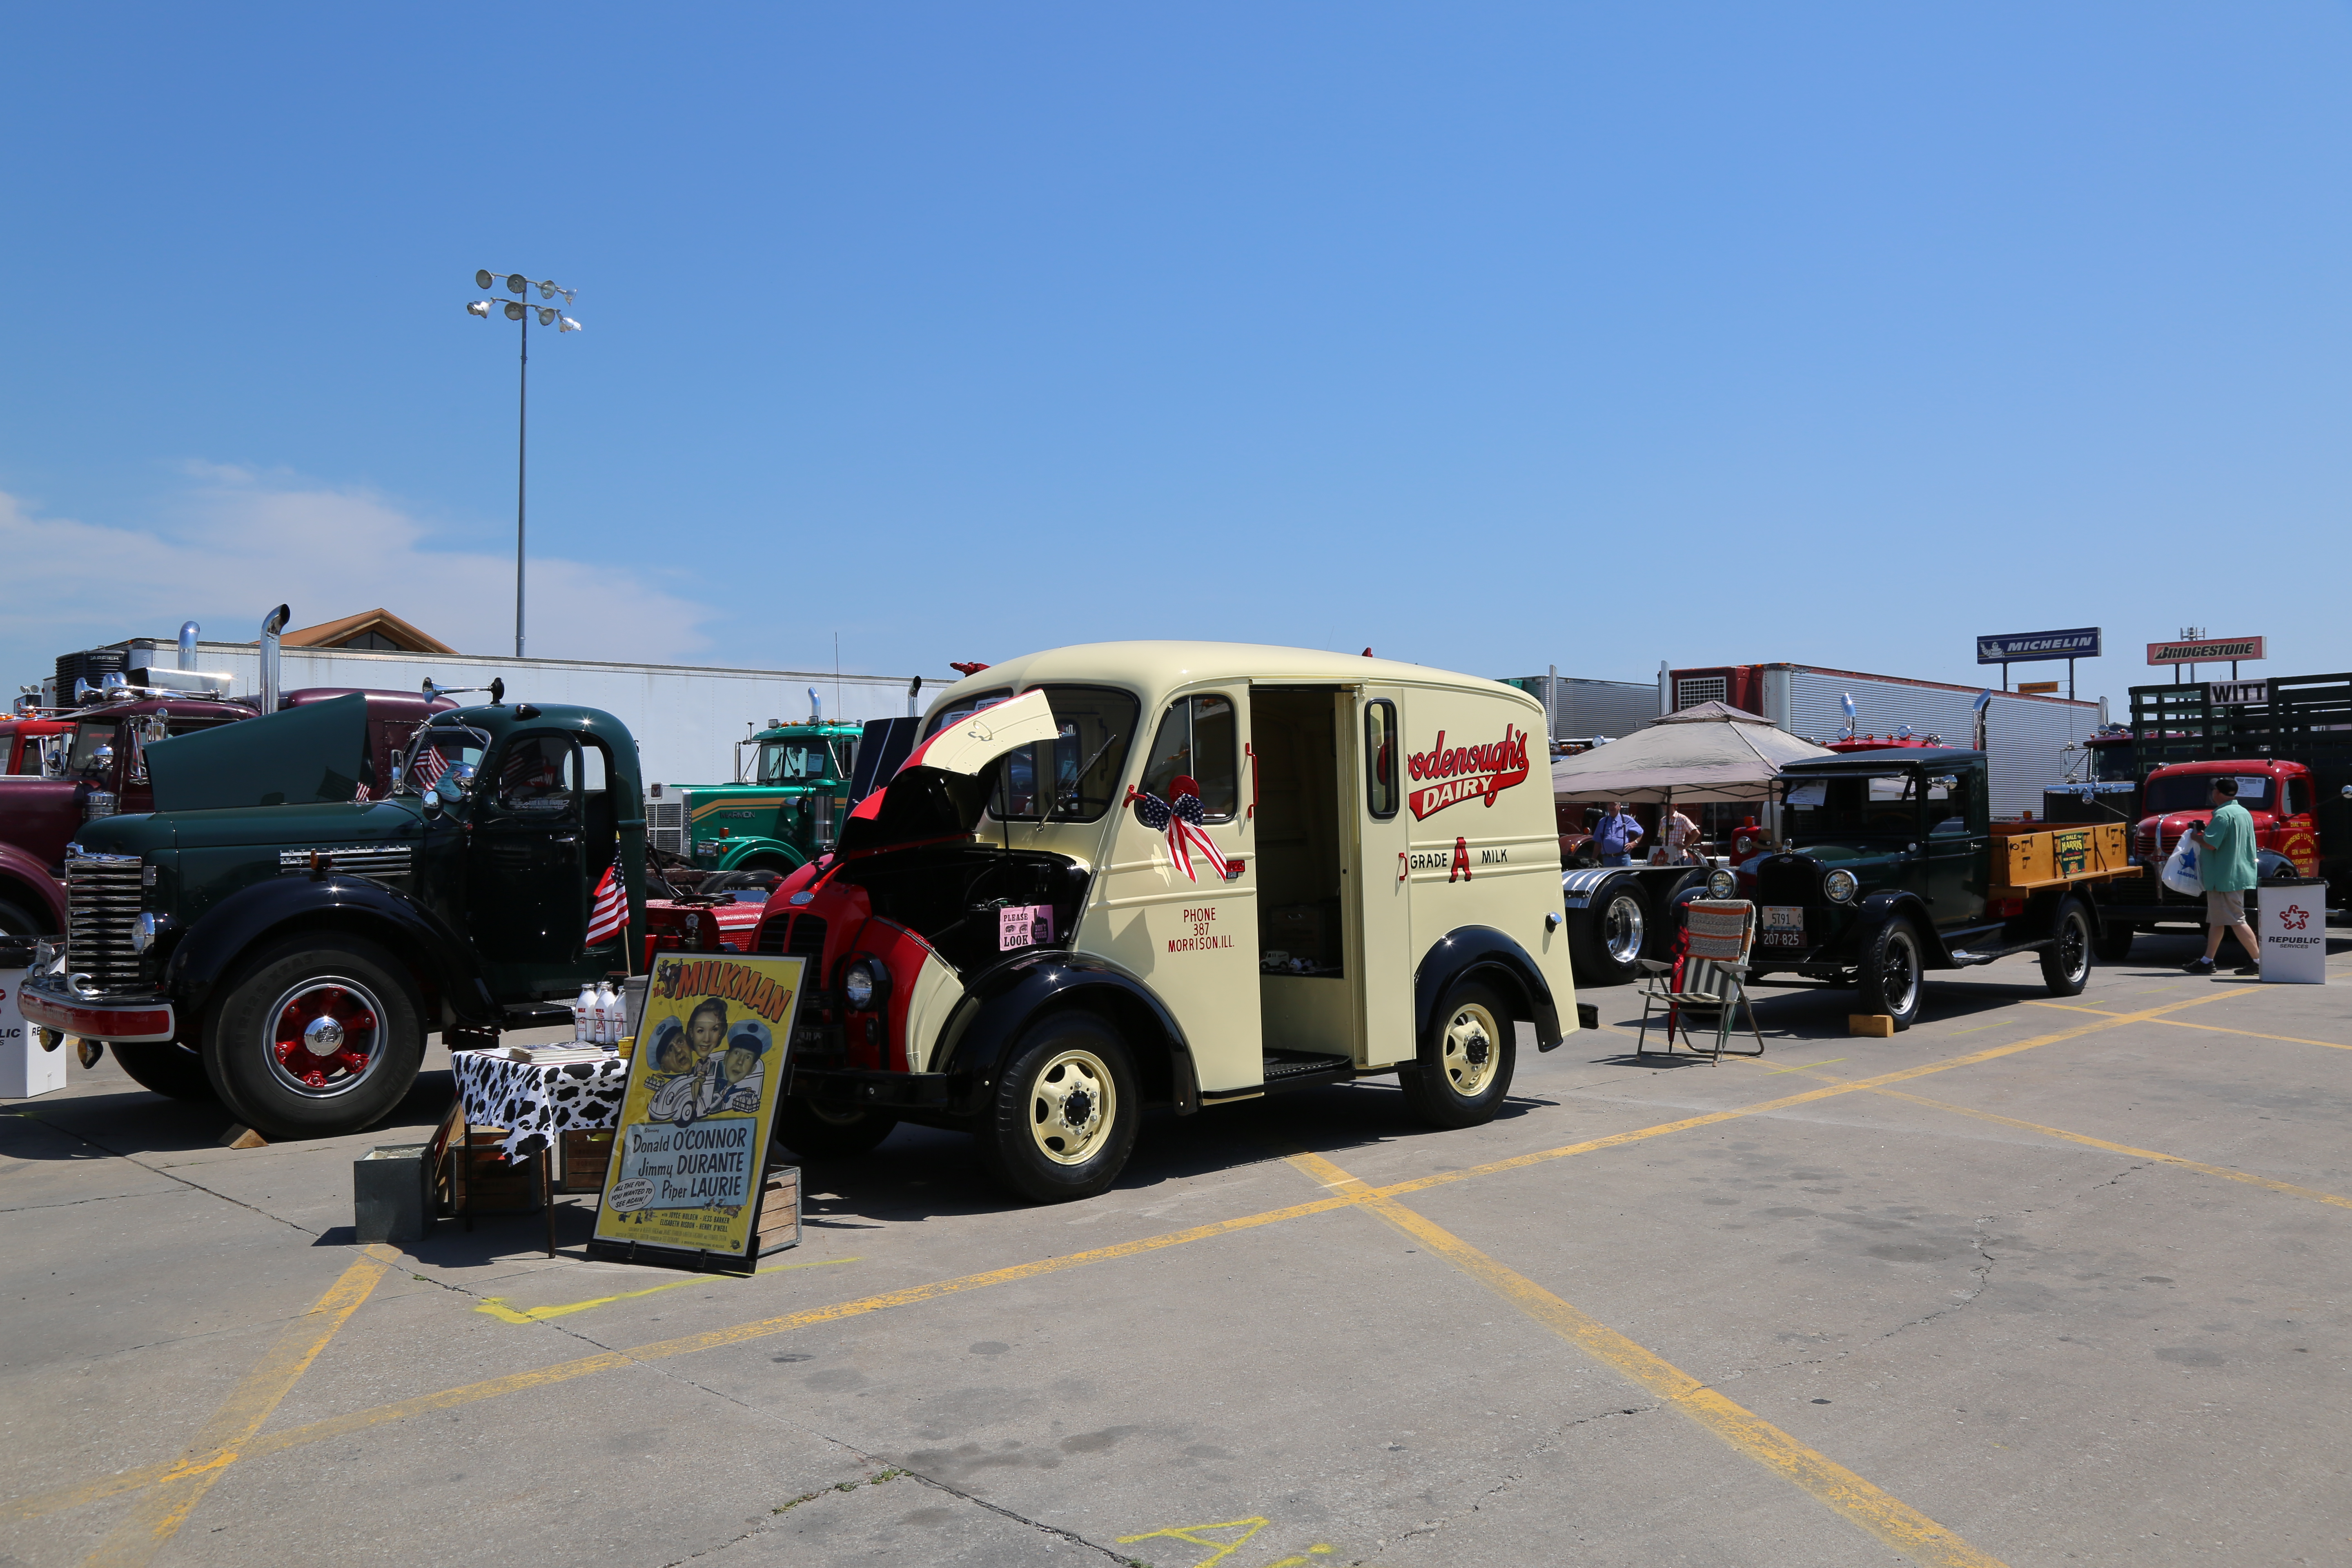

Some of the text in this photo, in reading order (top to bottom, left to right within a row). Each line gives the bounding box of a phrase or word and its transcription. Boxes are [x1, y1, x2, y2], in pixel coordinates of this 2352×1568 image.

[2007, 637, 2092, 652] MICHELIN
[2154, 642, 2254, 660] BRIDGESTONE
[2212, 682, 2266, 702] WITT
[1422, 776, 1493, 815] DAIRY
[2062, 840, 2082, 853] HARRIS
[1410, 837, 1508, 883] GRADE A MILK
[1004, 913, 1028, 922] PLEASE
[1184, 907, 1216, 923] PHONE
[1772, 913, 1791, 924] 5791
[1035, 923, 1046, 932] DON'T
[1194, 922, 1209, 936] 387
[1004, 935, 1029, 947] LOOK
[653, 983, 665, 998] The
[675, 961, 793, 1024] MILKMAN
[633, 1127, 747, 1153] Donald O'CONNOR
[638, 1152, 744, 1178] Jimmy DURANTE
[611, 1193, 623, 1201] YOU
[623, 1188, 645, 1198] WANTED
[662, 1176, 742, 1201] Piper LAURIE
[615, 1195, 648, 1208] SEE AGAIN!
[660, 1219, 679, 1227] ELISABETH
